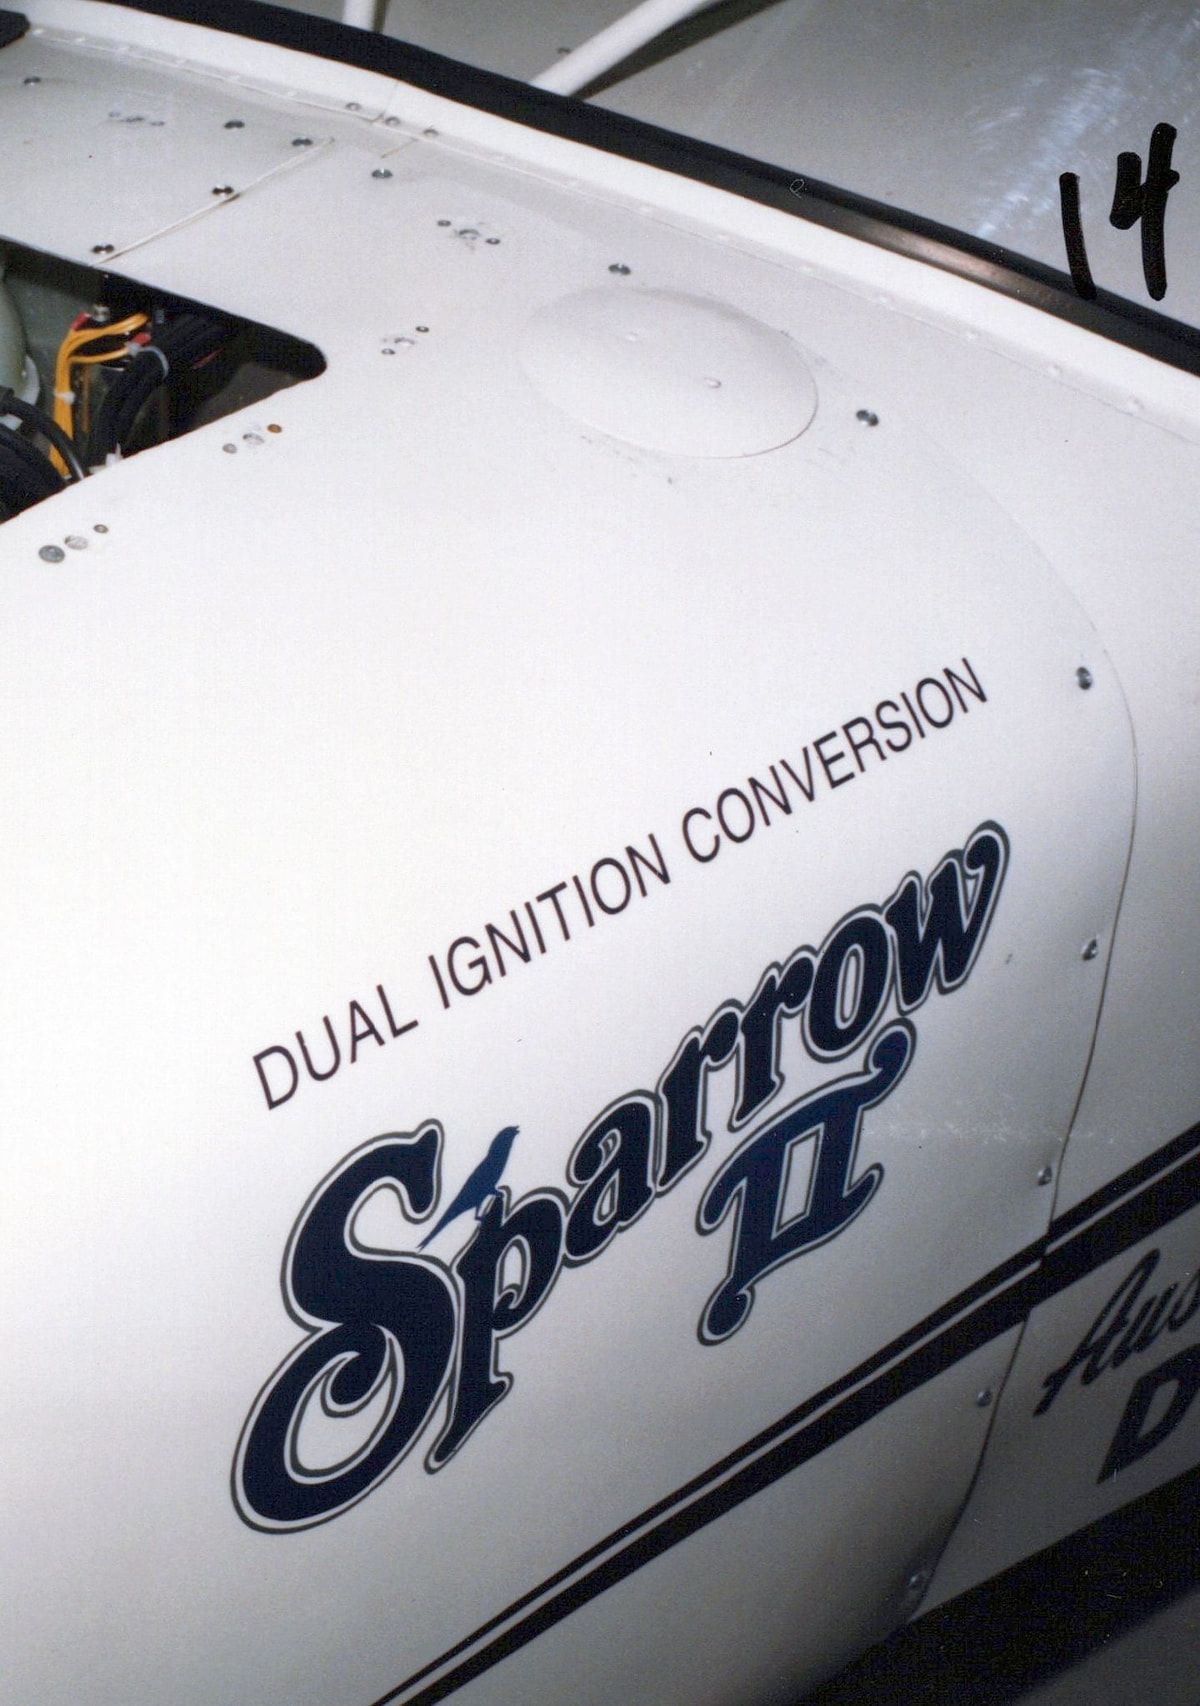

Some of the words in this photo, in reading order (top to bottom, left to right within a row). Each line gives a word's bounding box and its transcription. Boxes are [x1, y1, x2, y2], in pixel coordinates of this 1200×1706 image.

[252, 983, 419, 1110] DUAL
[427, 833, 672, 1010] IGNITION
[681, 657, 989, 863] CONVERSION
[230, 820, 1011, 1535] Sparrow
[694, 1017, 918, 1346] II
